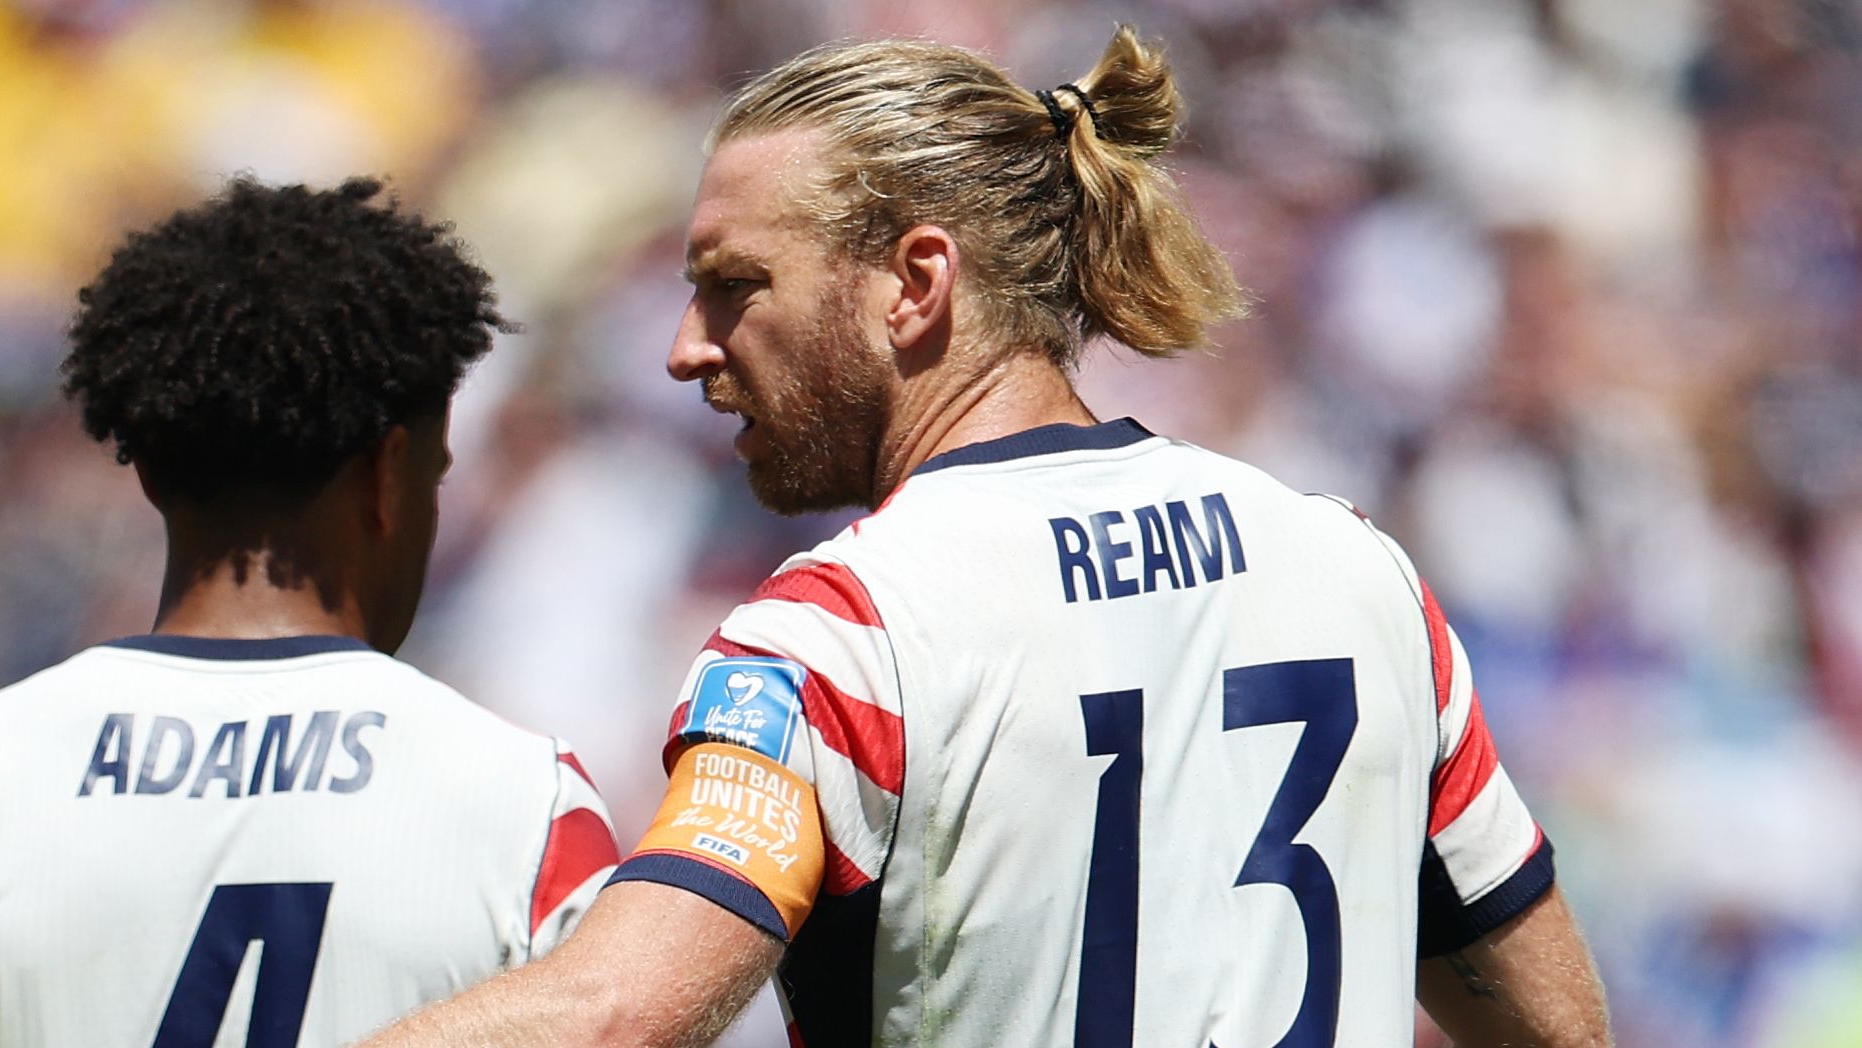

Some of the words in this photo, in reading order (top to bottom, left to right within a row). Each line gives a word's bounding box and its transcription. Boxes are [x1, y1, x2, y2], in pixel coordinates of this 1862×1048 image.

[1049, 492, 1247, 602] REAM
[704, 704, 742, 727] Unite
[743, 709, 767, 730] For
[76, 710, 386, 798] ADAMS
[695, 753, 802, 816] FOOTBALL
[670, 806, 715, 828] the
[714, 813, 798, 873] World
[690, 777, 801, 843] UNITES
[698, 837, 742, 862] FIFA
